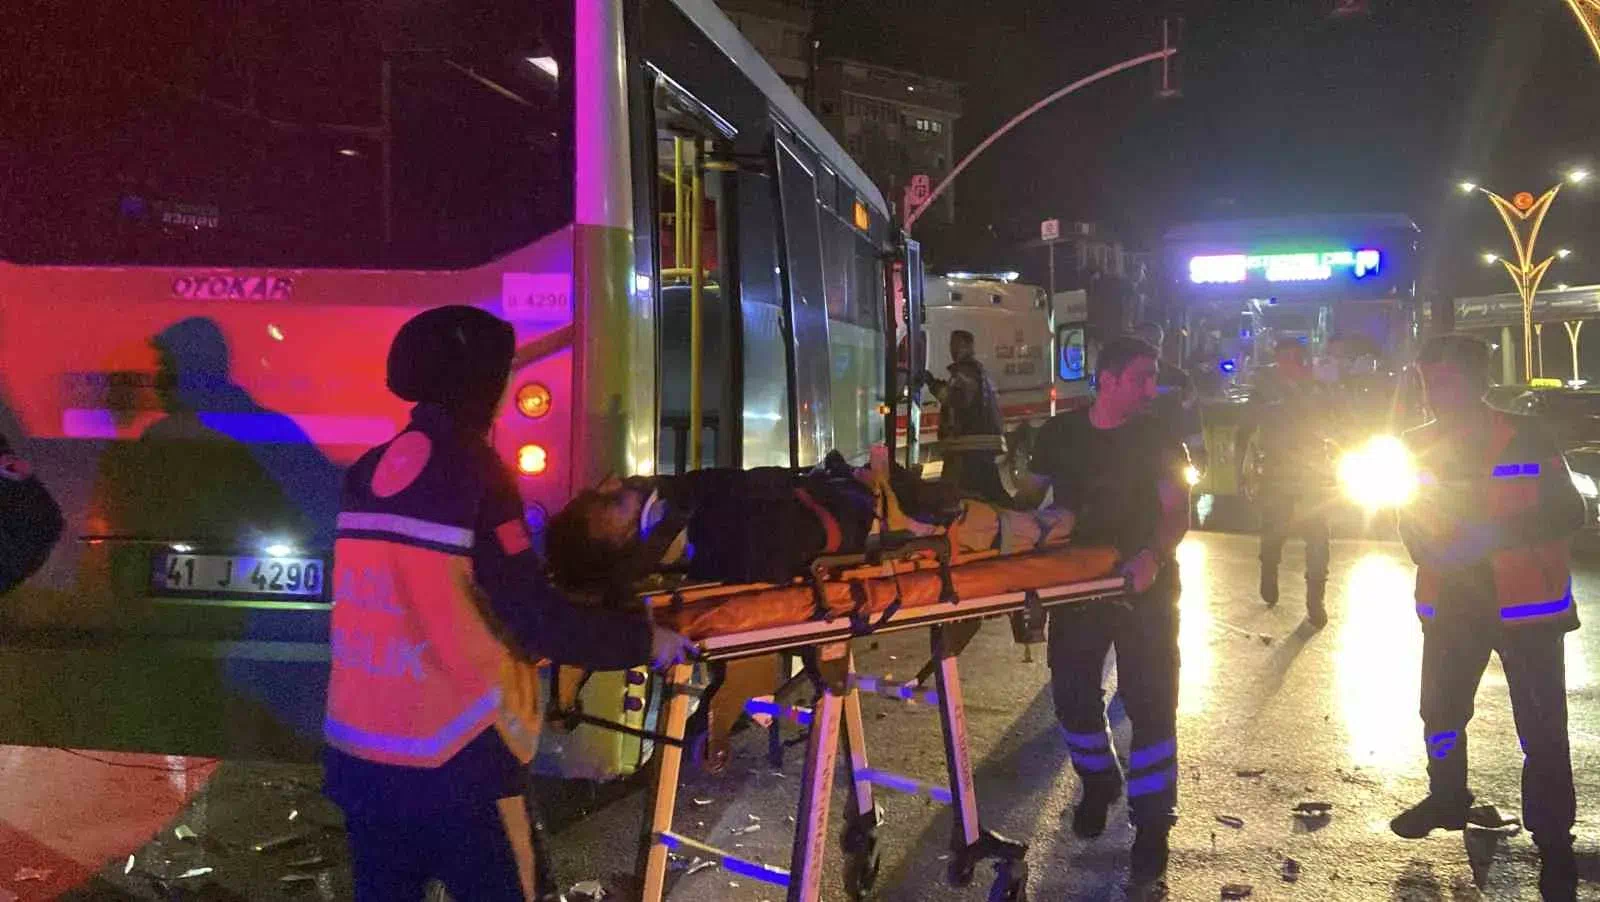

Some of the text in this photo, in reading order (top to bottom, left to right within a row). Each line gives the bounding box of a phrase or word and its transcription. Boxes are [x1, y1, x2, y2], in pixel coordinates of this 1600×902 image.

[171, 276, 293, 298] OTOKAR
[167, 557, 320, 592] 41 J 4290
